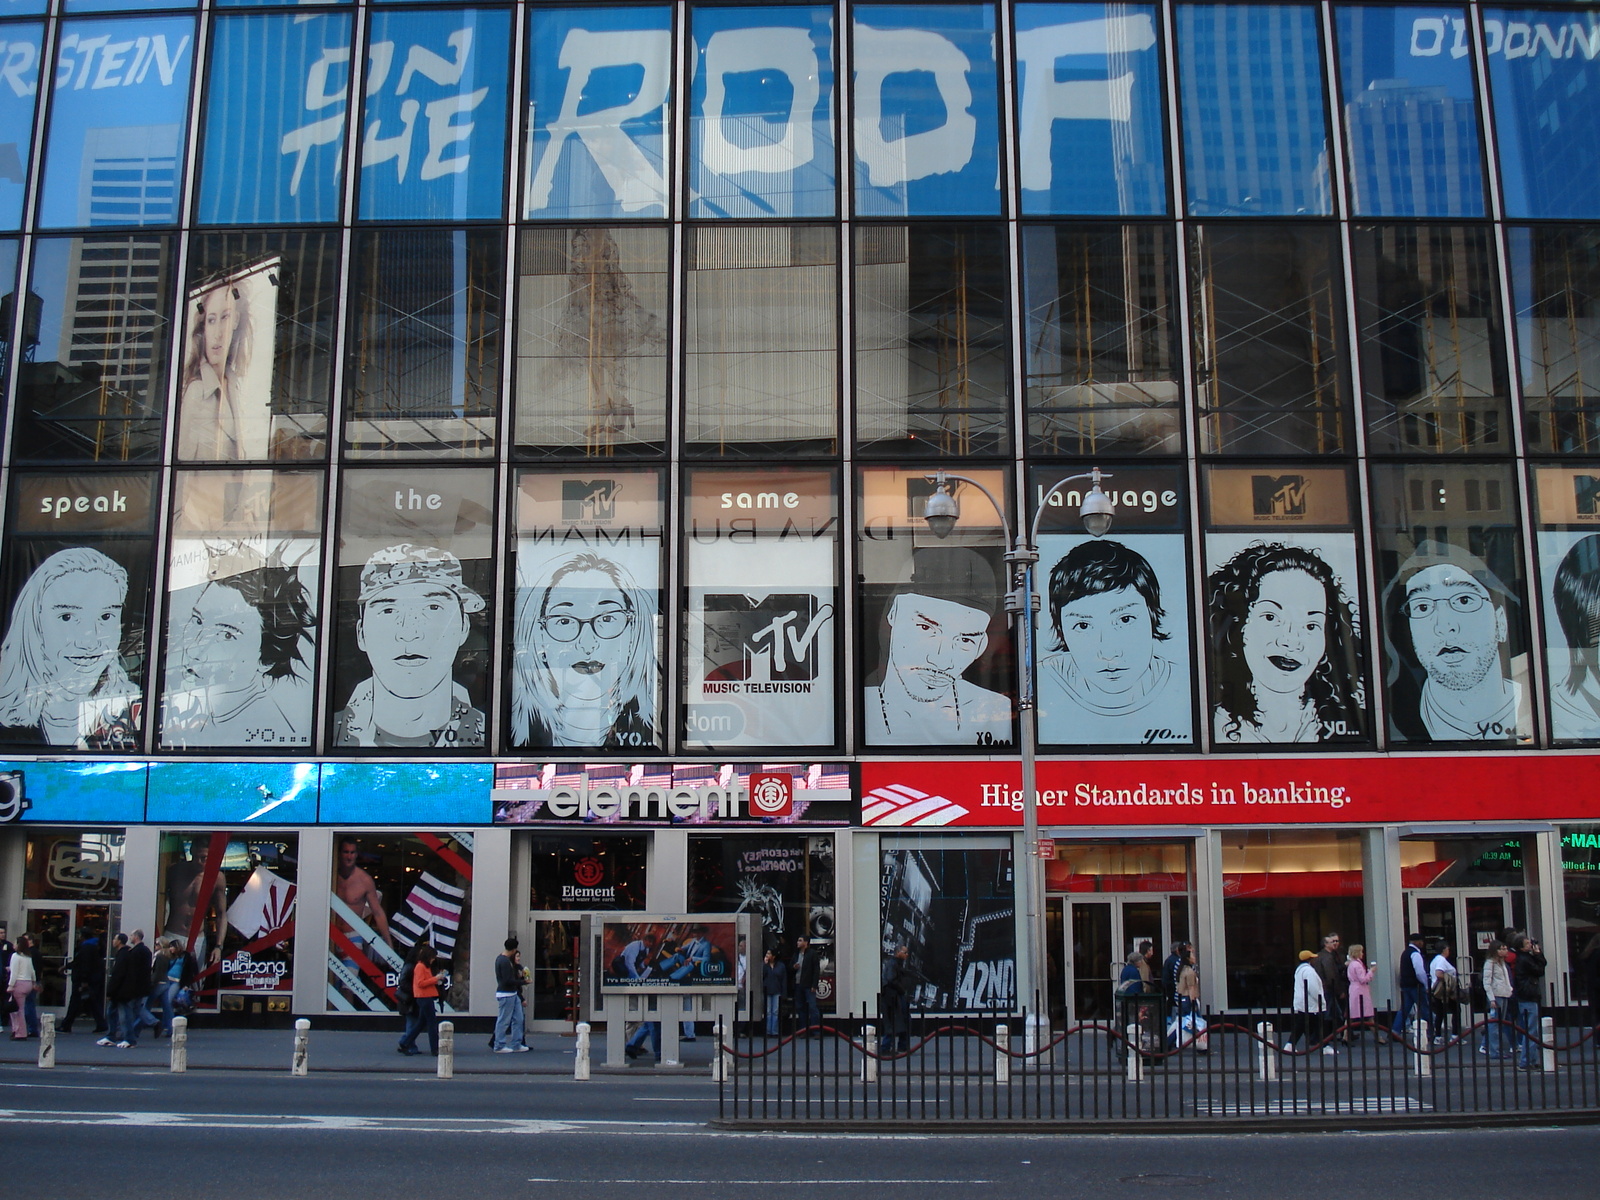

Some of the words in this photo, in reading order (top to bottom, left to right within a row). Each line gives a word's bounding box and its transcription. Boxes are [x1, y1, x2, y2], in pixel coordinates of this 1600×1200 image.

[305, 27, 473, 111] ON
[526, 14, 1157, 212] ROOF
[281, 86, 489, 197] THE
[40, 490, 127, 518] speak
[394, 488, 442, 511] the
[720, 492, 800, 509] same
[1037, 484, 1178, 513] lanuage
[562, 479, 624, 520] MTV
[1251, 475, 1312, 516] MTV
[703, 593, 834, 682] MTV
[703, 682, 741, 694] MUSIC
[743, 682, 812, 694] TELEVISION
[547, 772, 744, 818] element
[980, 783, 1069, 812] Higer
[1074, 782, 1204, 807] Standards
[1210, 781, 1237, 806] in
[1241, 780, 1352, 809] banking.
[561, 885, 616, 897] Element
[959, 959, 1015, 1009] 42ND
